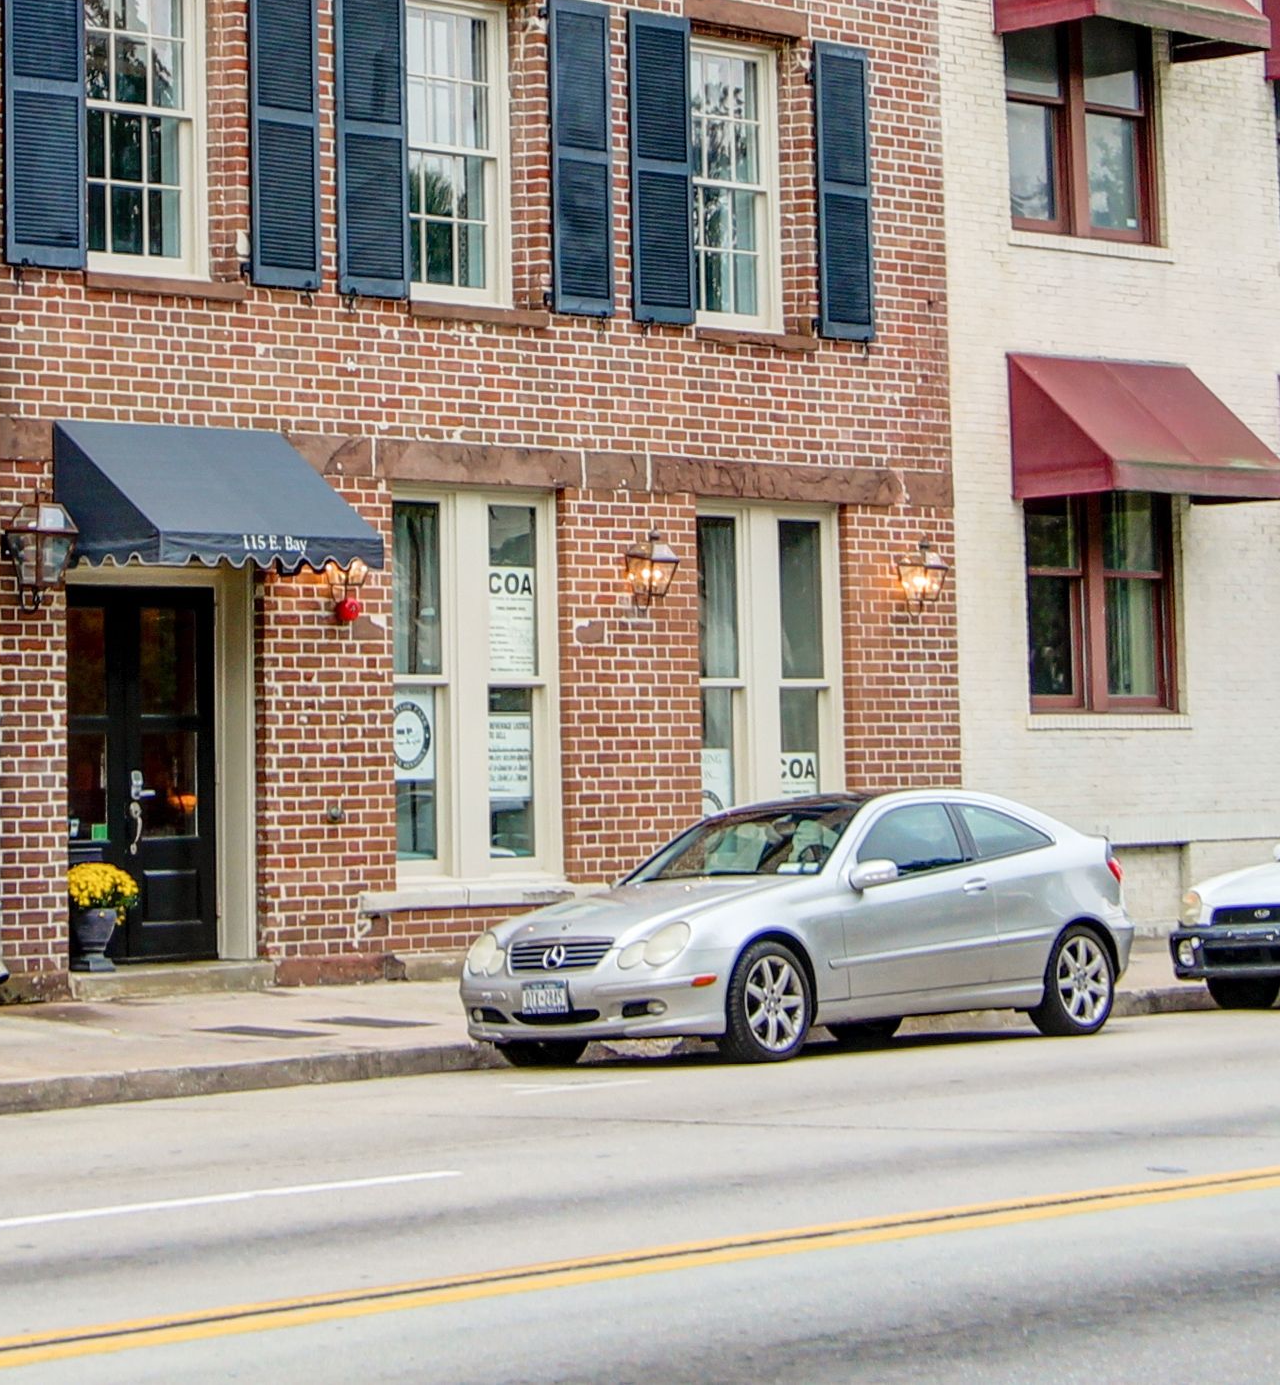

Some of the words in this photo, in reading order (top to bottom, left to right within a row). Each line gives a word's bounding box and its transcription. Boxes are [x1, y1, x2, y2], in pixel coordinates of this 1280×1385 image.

[243, 534, 266, 550] 115
[269, 534, 282, 550] E.
[285, 535, 307, 555] Bay
[489, 572, 533, 595] COA
